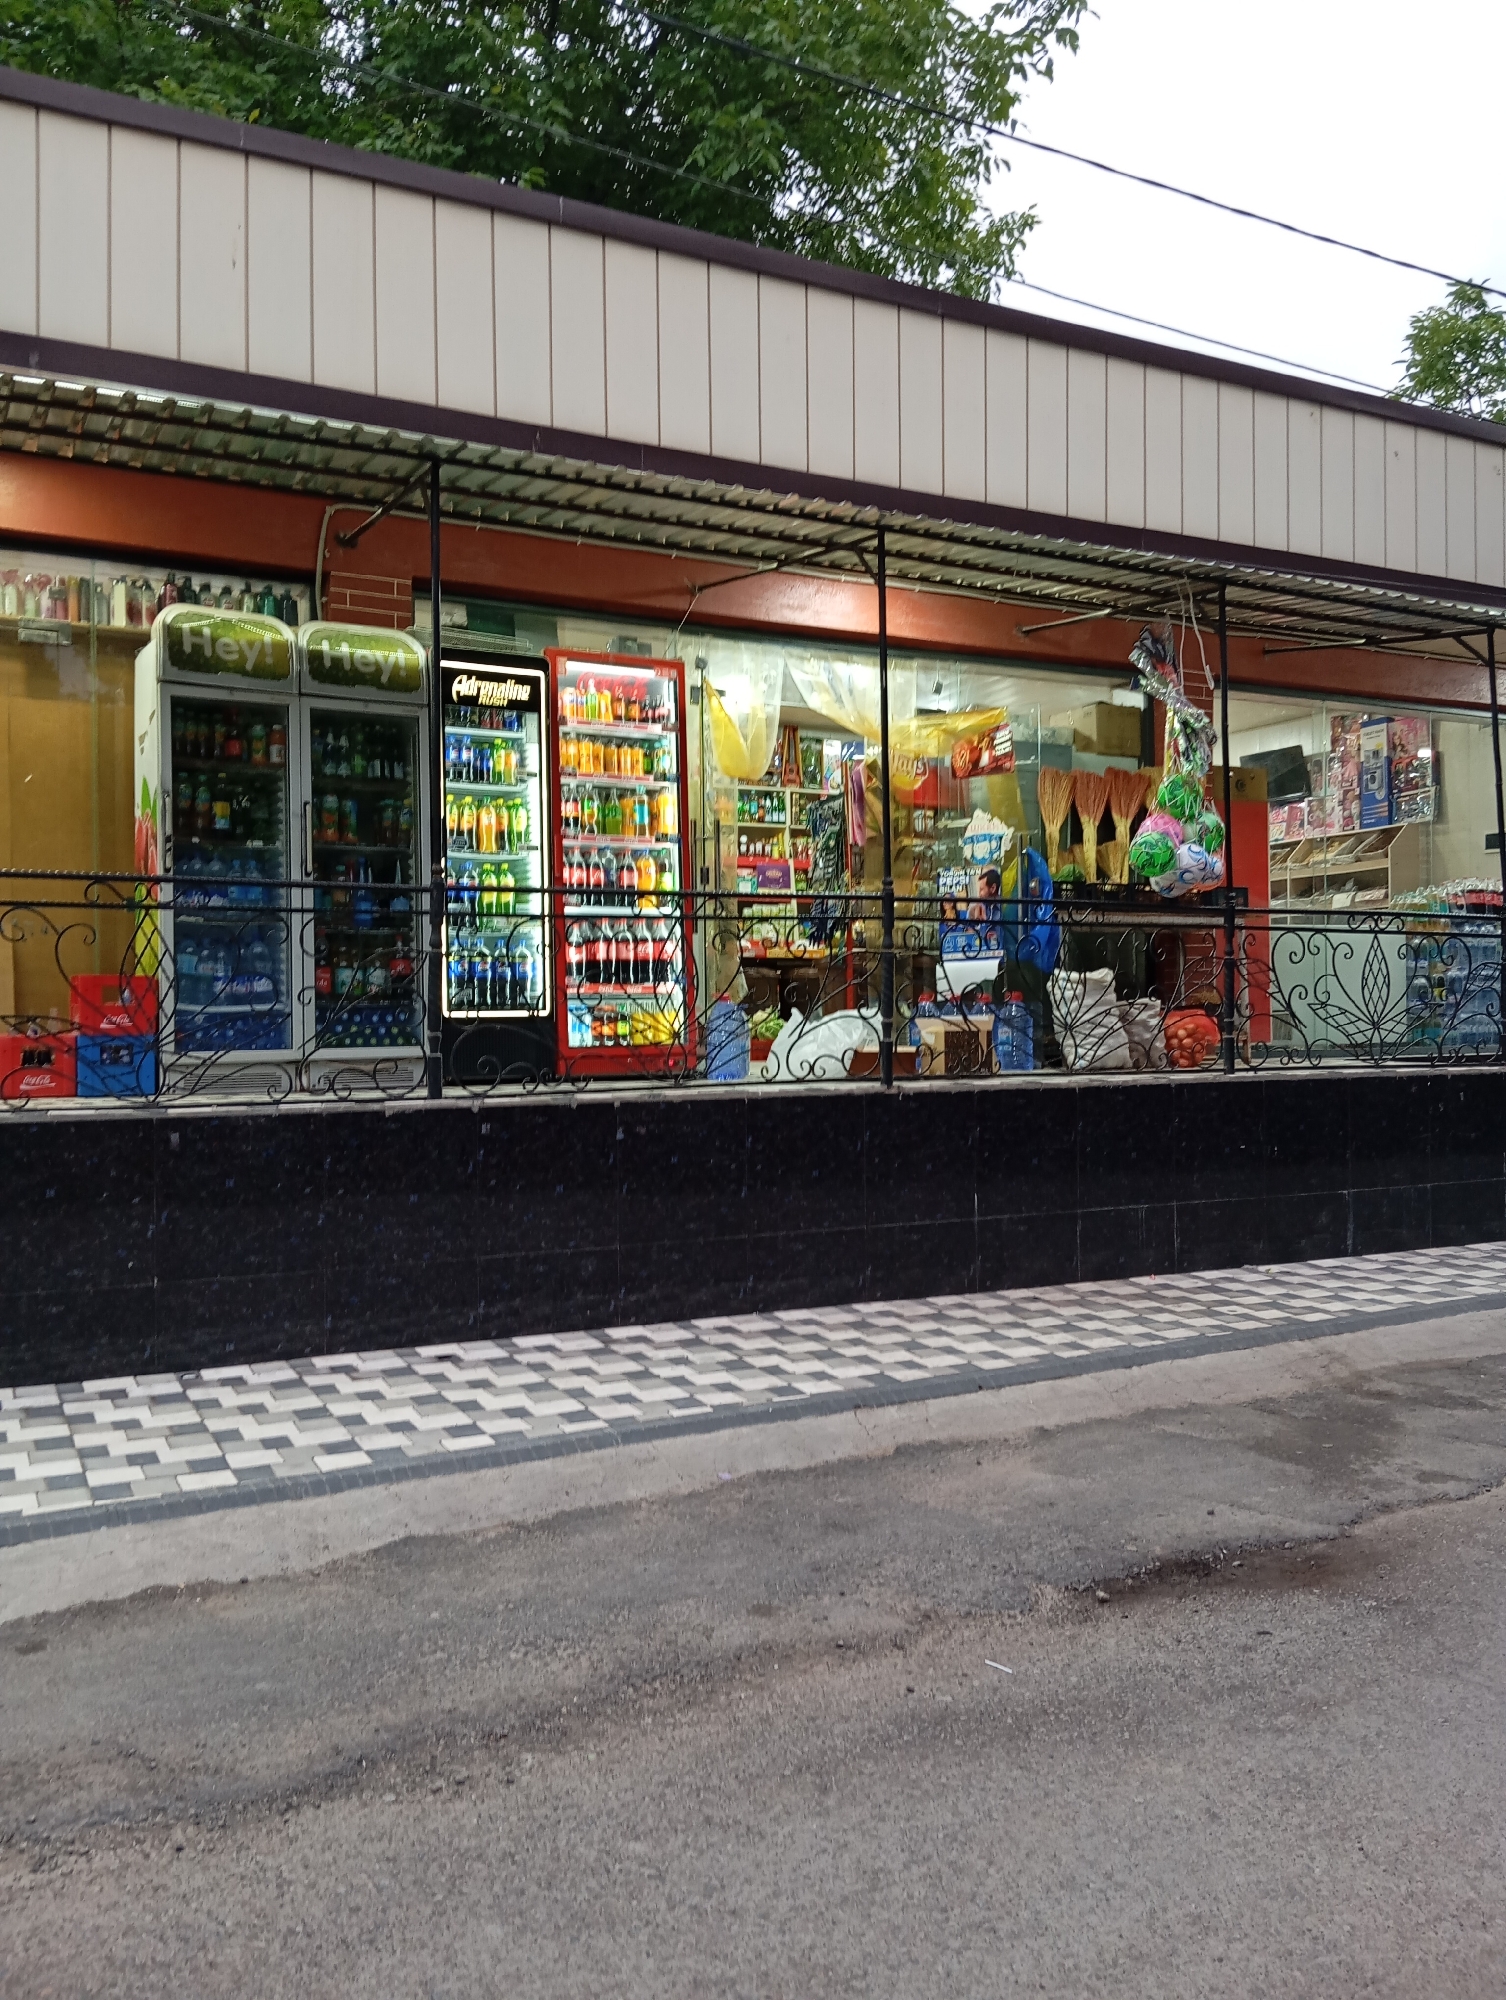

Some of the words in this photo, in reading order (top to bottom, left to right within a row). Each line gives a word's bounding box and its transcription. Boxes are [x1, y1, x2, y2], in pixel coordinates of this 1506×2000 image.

[182, 624, 274, 672] Hey!
[321, 638, 407, 684] Hey!
[452, 674, 531, 704] Adrenaline
[478, 696, 508, 708] RUSH
[939, 876, 969, 885] PEPSI
